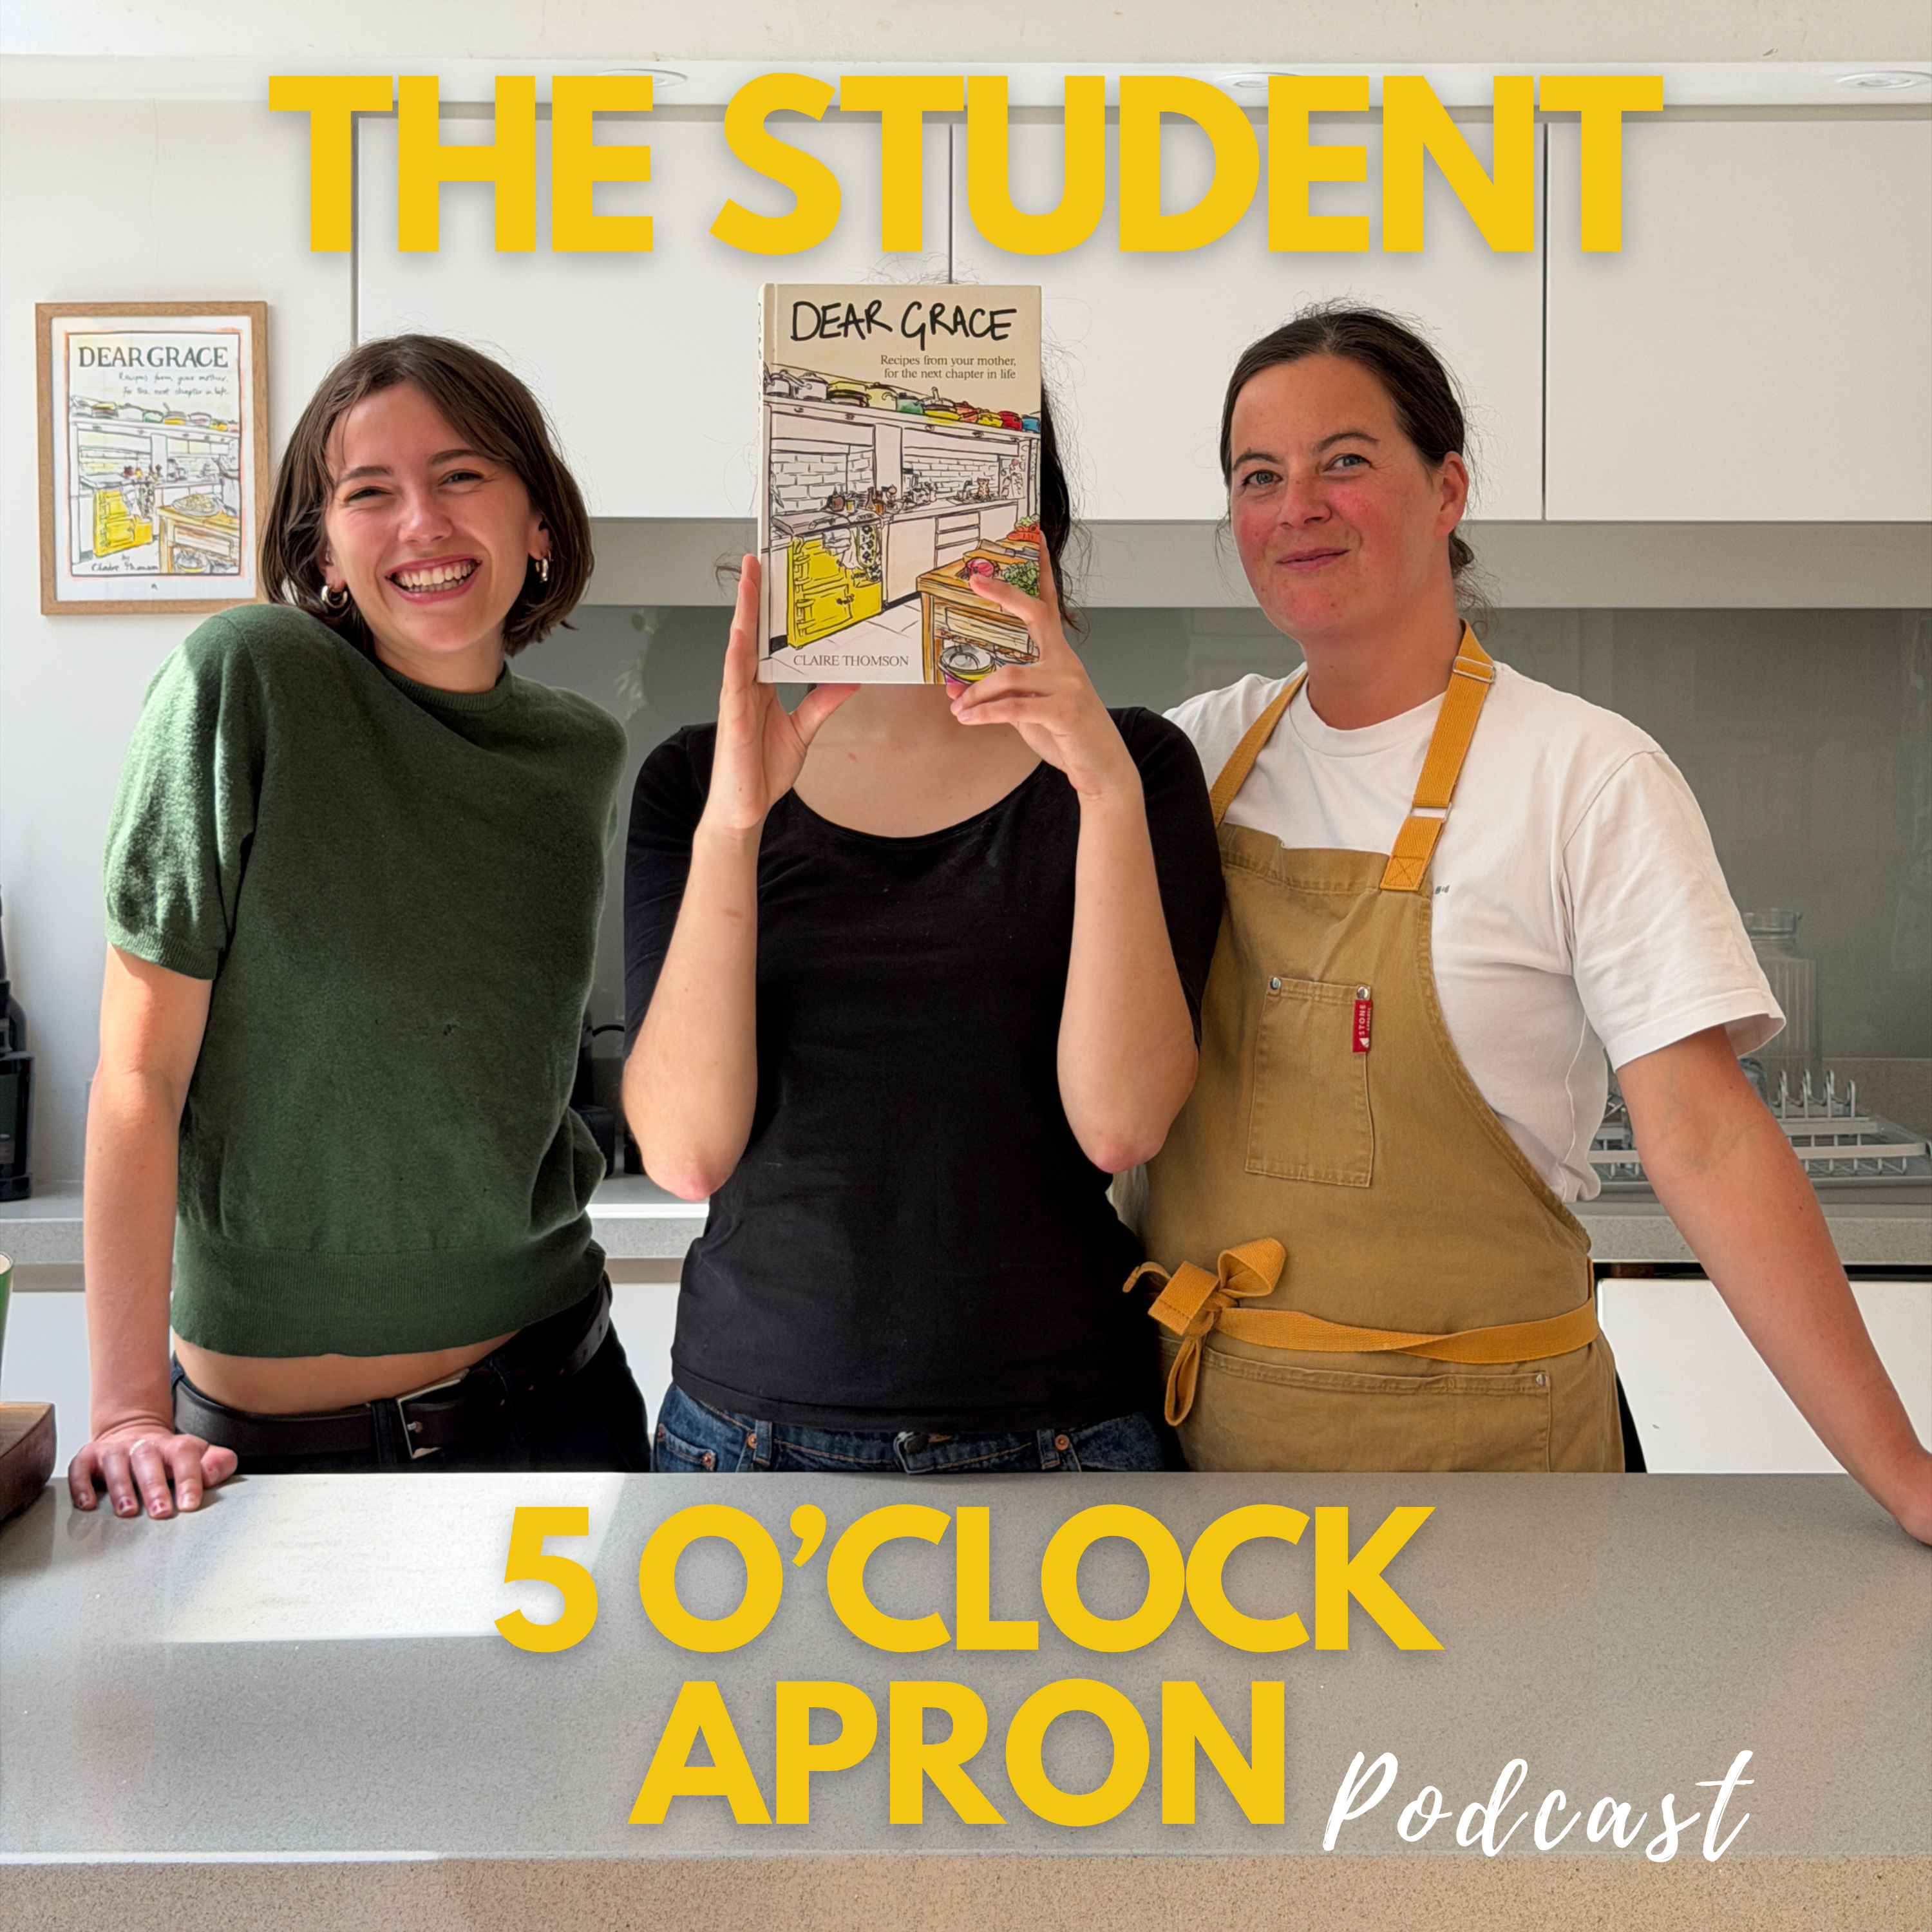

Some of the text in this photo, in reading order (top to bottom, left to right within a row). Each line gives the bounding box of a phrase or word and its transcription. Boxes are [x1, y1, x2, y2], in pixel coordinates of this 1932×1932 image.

[790, 299, 1017, 350] DEAR GRACE
[79, 346, 229, 368] DEAR GRACE
[880, 355, 1016, 367] Recipes from your mother,
[884, 368, 1016, 380] for the next chapter in life
[793, 655, 909, 667] CLAIRE THOMSON
